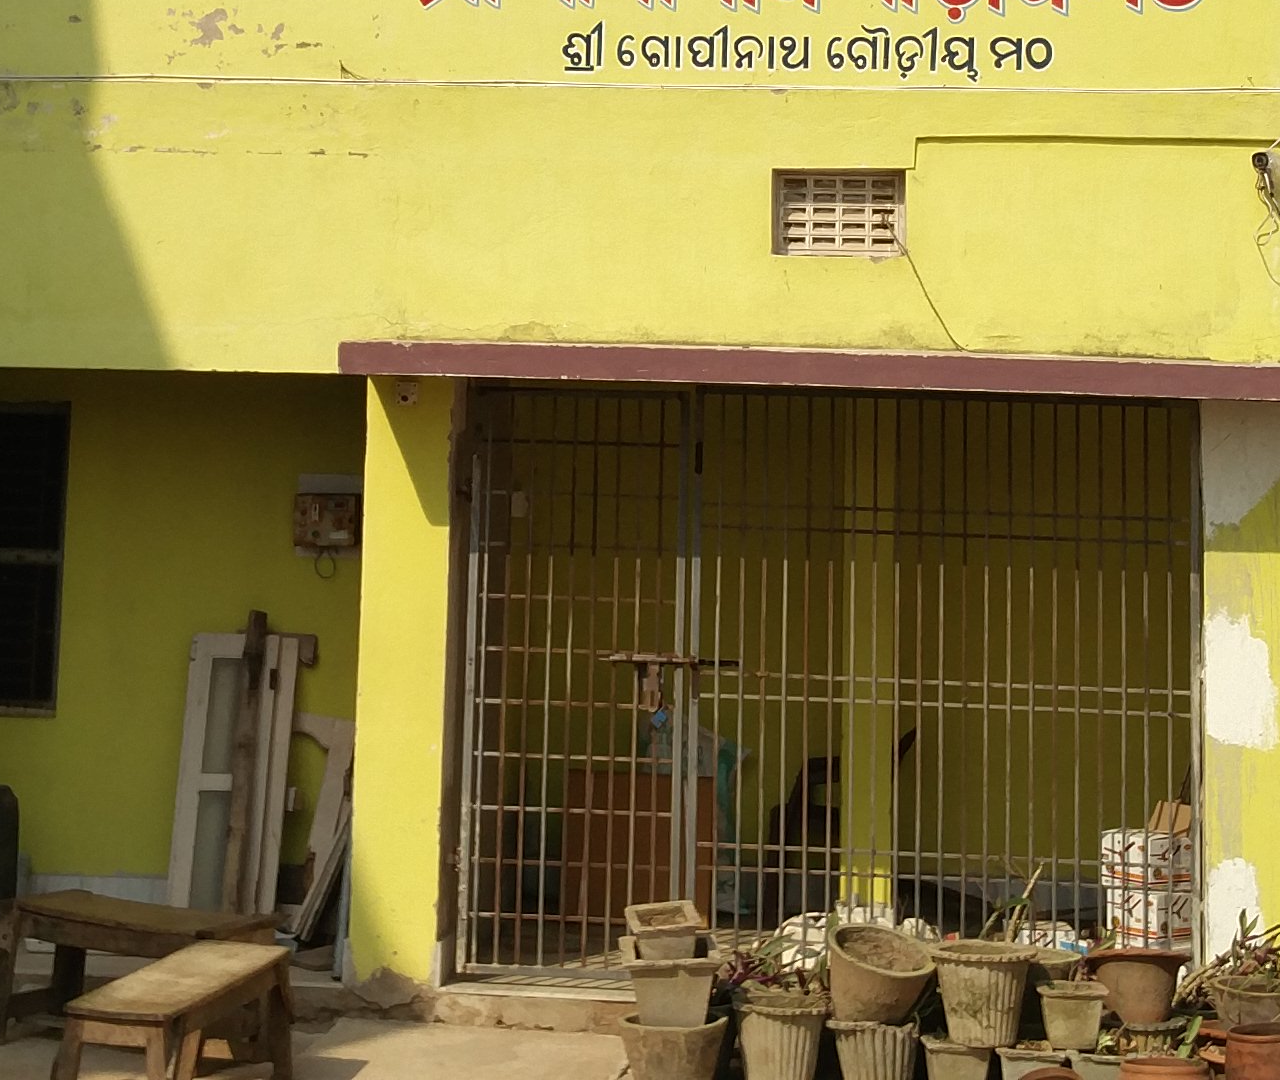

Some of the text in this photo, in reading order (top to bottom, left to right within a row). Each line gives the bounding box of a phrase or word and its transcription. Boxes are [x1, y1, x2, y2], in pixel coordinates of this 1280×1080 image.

[561, 21, 605, 72] ଶ୍ରୀ
[616, 24, 811, 72] ଗୋପୀନାଥ
[989, 34, 1054, 72] ମଠ
